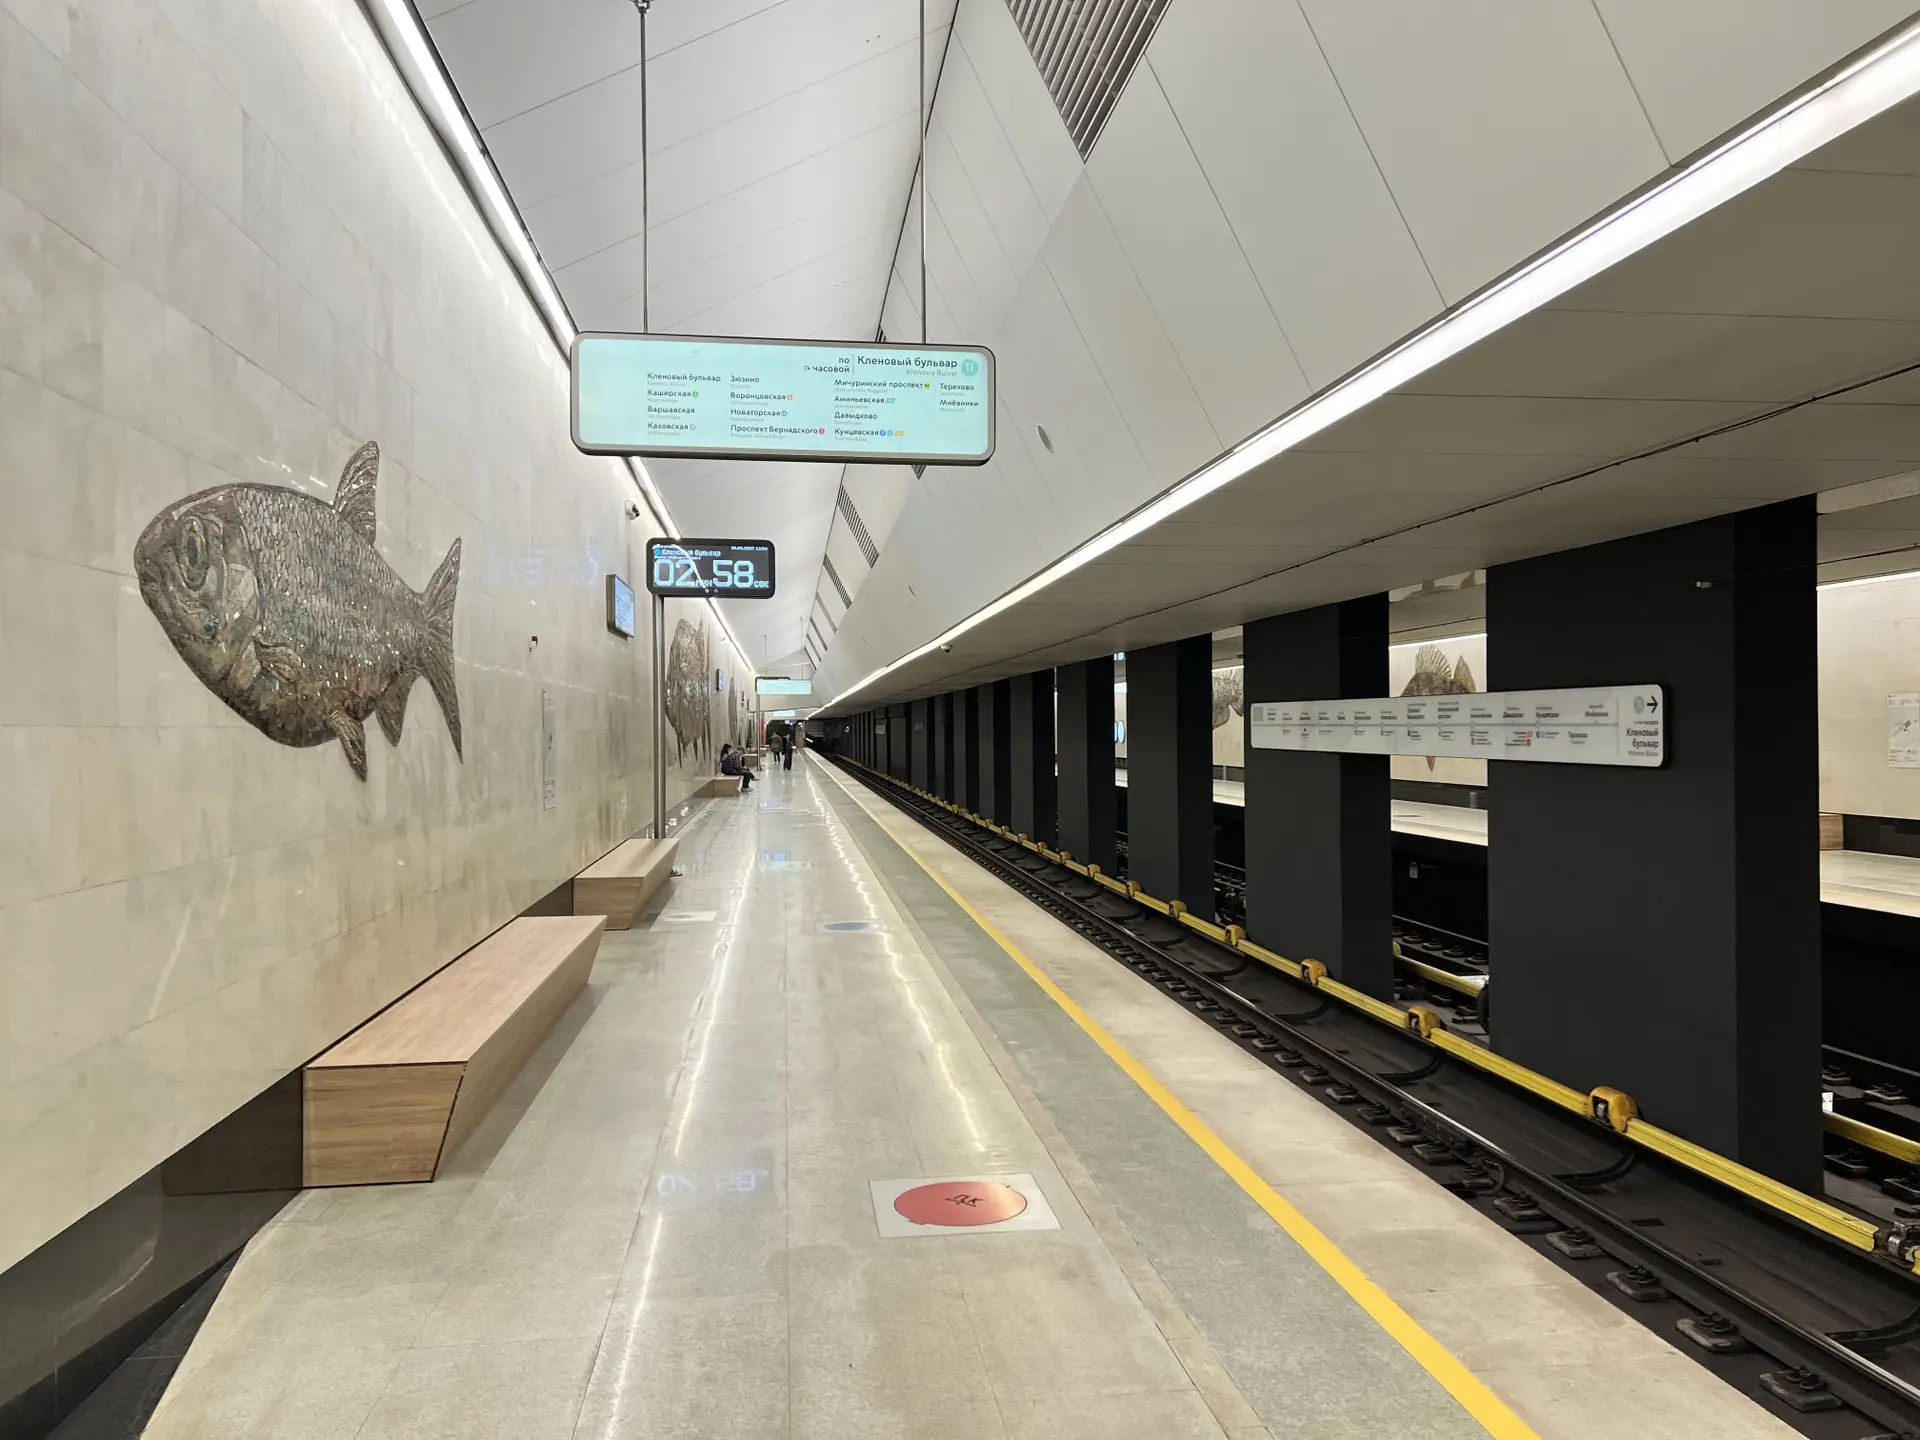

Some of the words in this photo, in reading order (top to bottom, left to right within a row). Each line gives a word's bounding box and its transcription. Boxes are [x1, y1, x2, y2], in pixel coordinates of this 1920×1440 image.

[838, 356, 850, 364] по
[857, 355, 912, 366] Кленовый
[914, 356, 958, 369] бульвар
[812, 364, 850, 373] часовой
[647, 372, 687, 381] Кленовый
[689, 373, 721, 383] бульвар
[730, 374, 760, 383] Зюзино
[834, 379, 888, 388] Мичуринский
[940, 382, 975, 391] Терехово
[647, 389, 691, 397] Каширская
[730, 391, 786, 400] Воронцовская
[834, 395, 885, 404] Аминьевская
[939, 399, 979, 407] Мнёвники
[647, 405, 695, 414] Варшавская
[730, 408, 781, 417] Новаторская
[834, 411, 878, 420] Давыдково
[647, 422, 689, 430] Каховская
[730, 424, 768, 433] Проспект
[769, 425, 818, 435] Вернадского
[834, 427, 879, 437] Кунцевская
[653, 558, 695, 587] 02
[712, 559, 754, 588] 58
